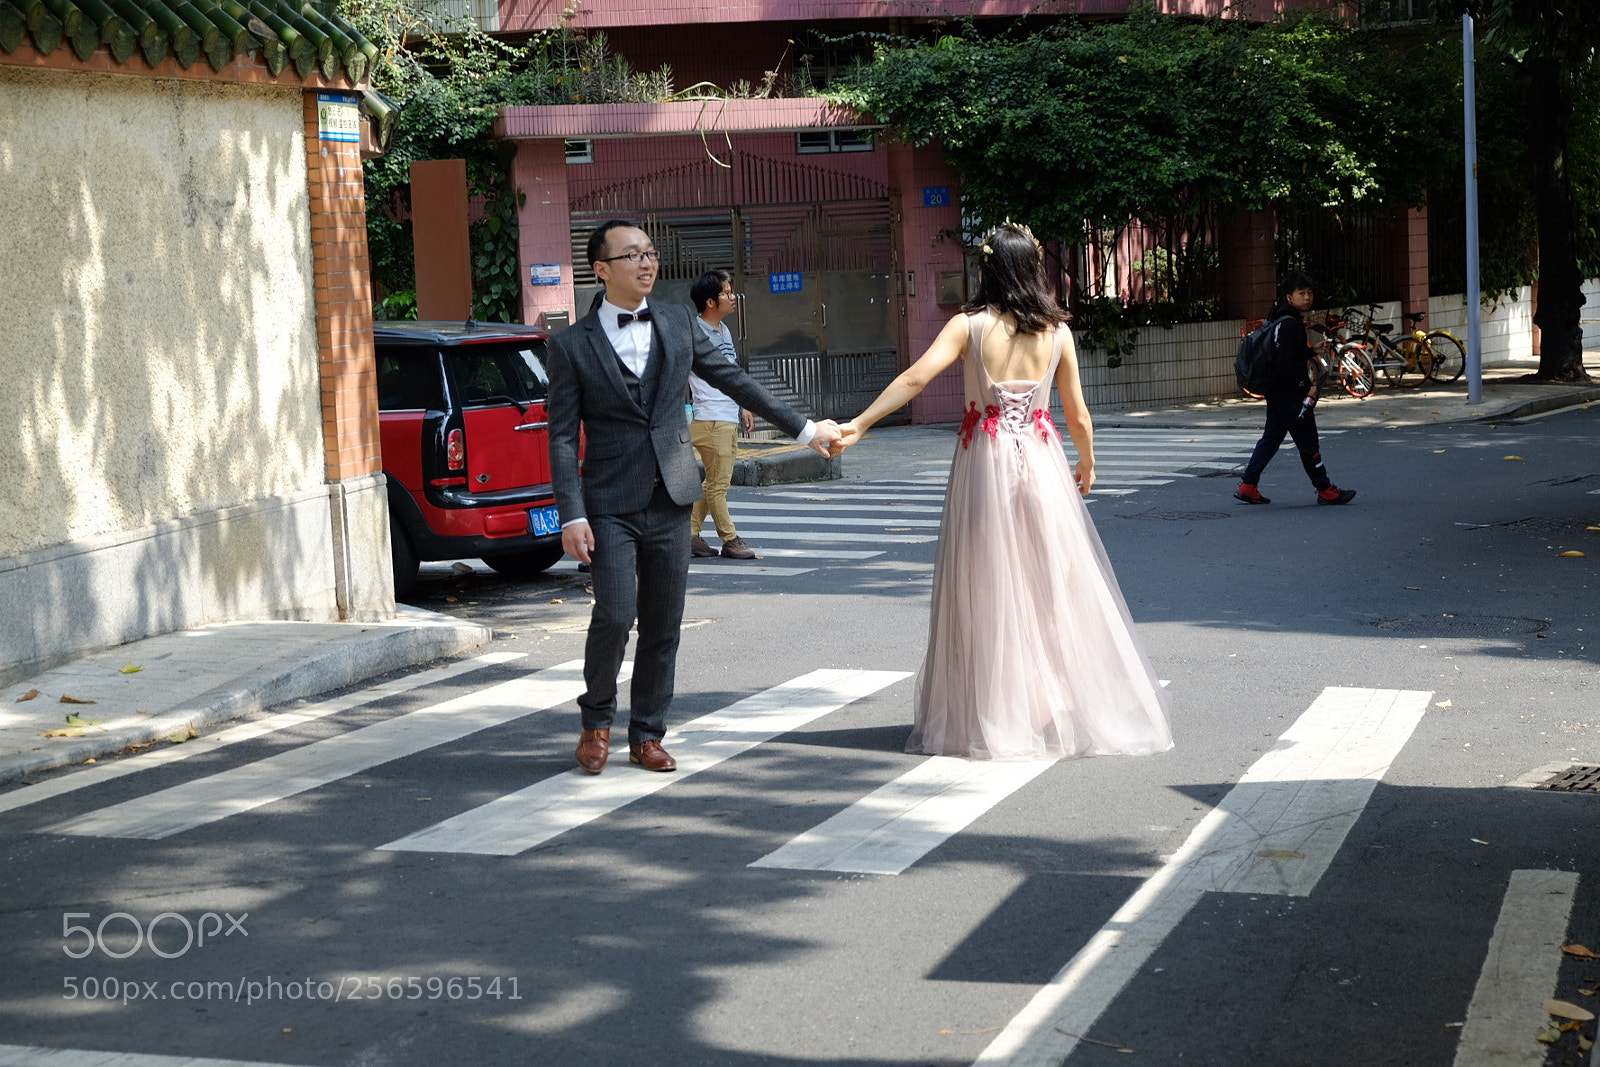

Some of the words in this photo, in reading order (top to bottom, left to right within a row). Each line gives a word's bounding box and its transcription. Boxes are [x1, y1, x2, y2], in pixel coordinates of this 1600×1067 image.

[930, 194, 942, 205] 20
[772, 282, 800, 291] 禁止停车
